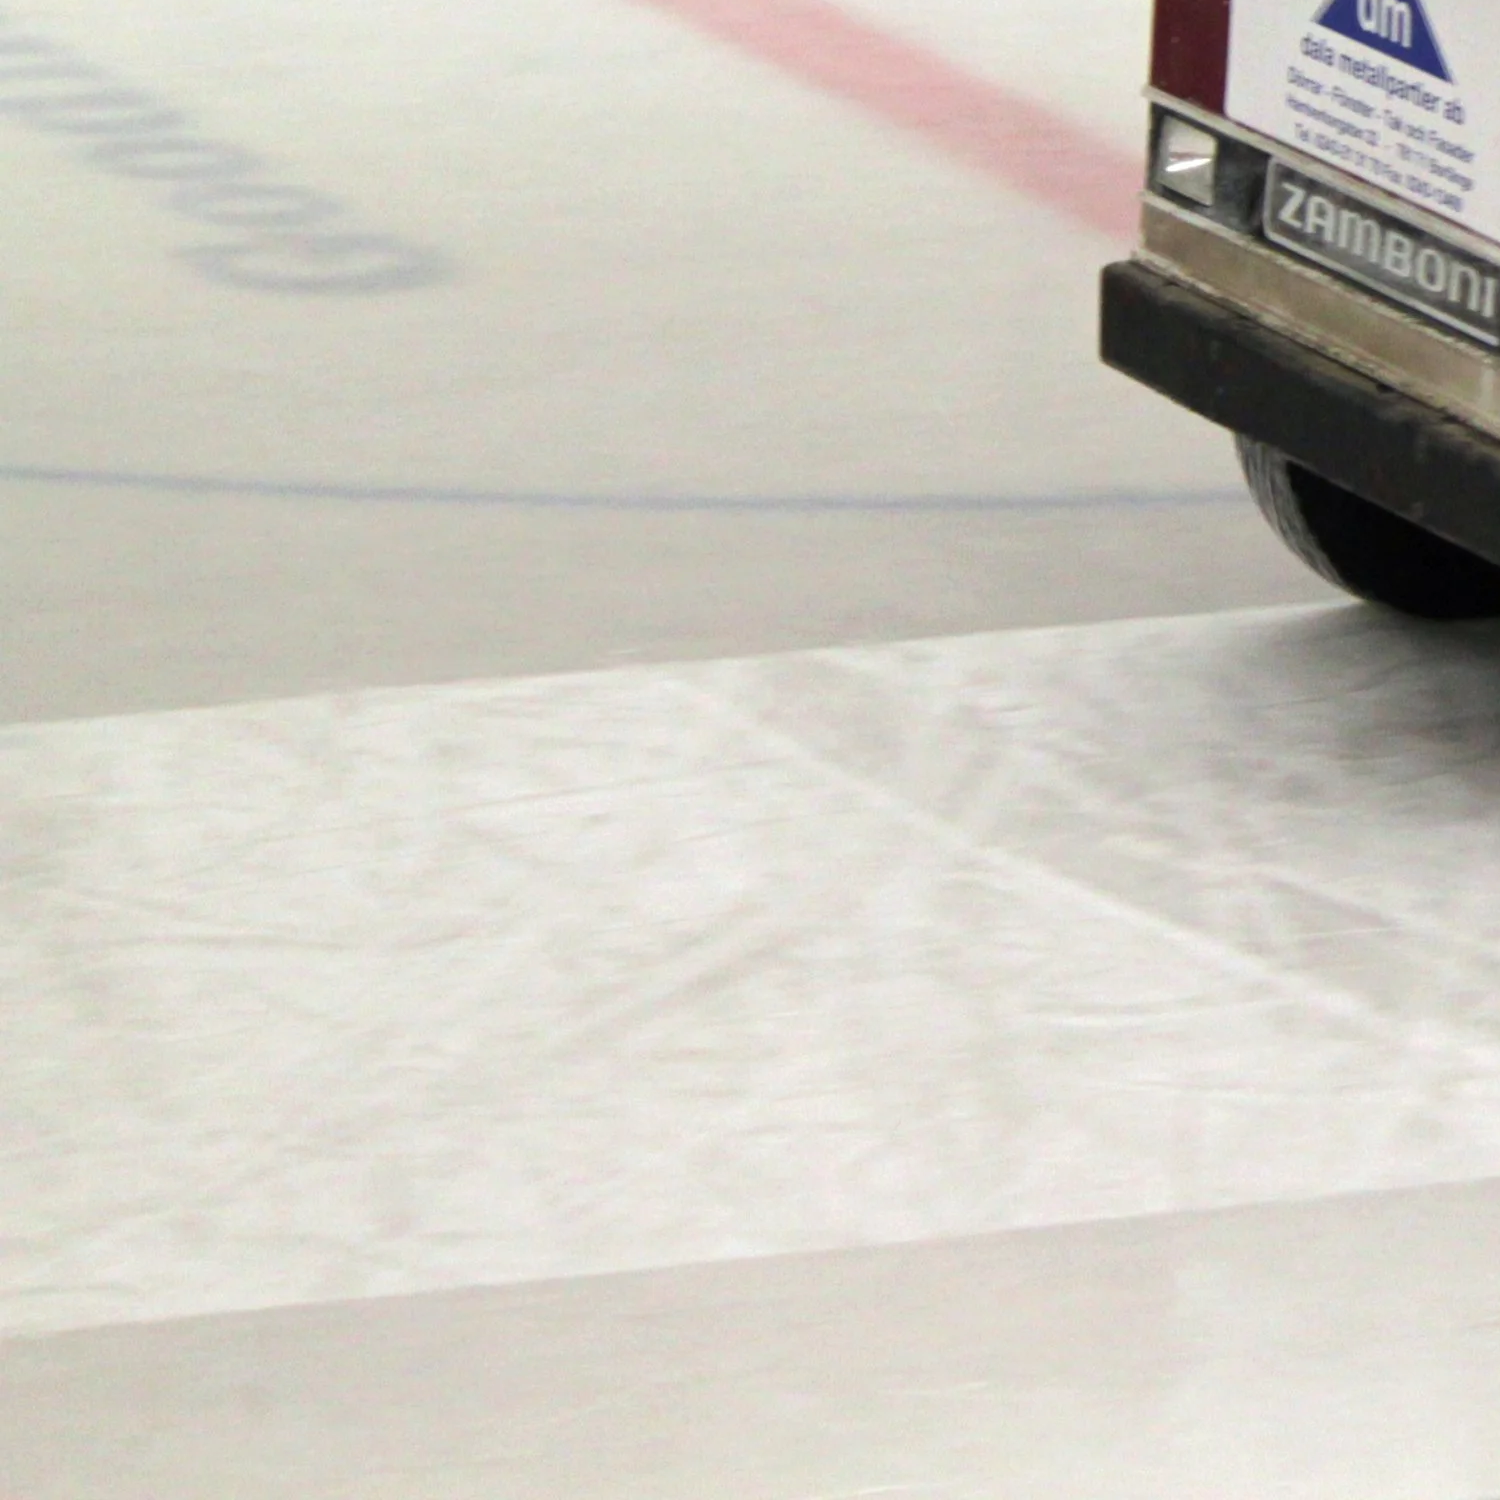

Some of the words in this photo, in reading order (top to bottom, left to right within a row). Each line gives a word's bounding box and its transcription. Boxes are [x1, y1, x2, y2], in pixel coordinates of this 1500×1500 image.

[1300, 32, 1335, 67] dala
[1338, 53, 1441, 112] metallpartier
[1443, 96, 1465, 125] ab
[1277, 182, 1500, 319] ZAMBONI
